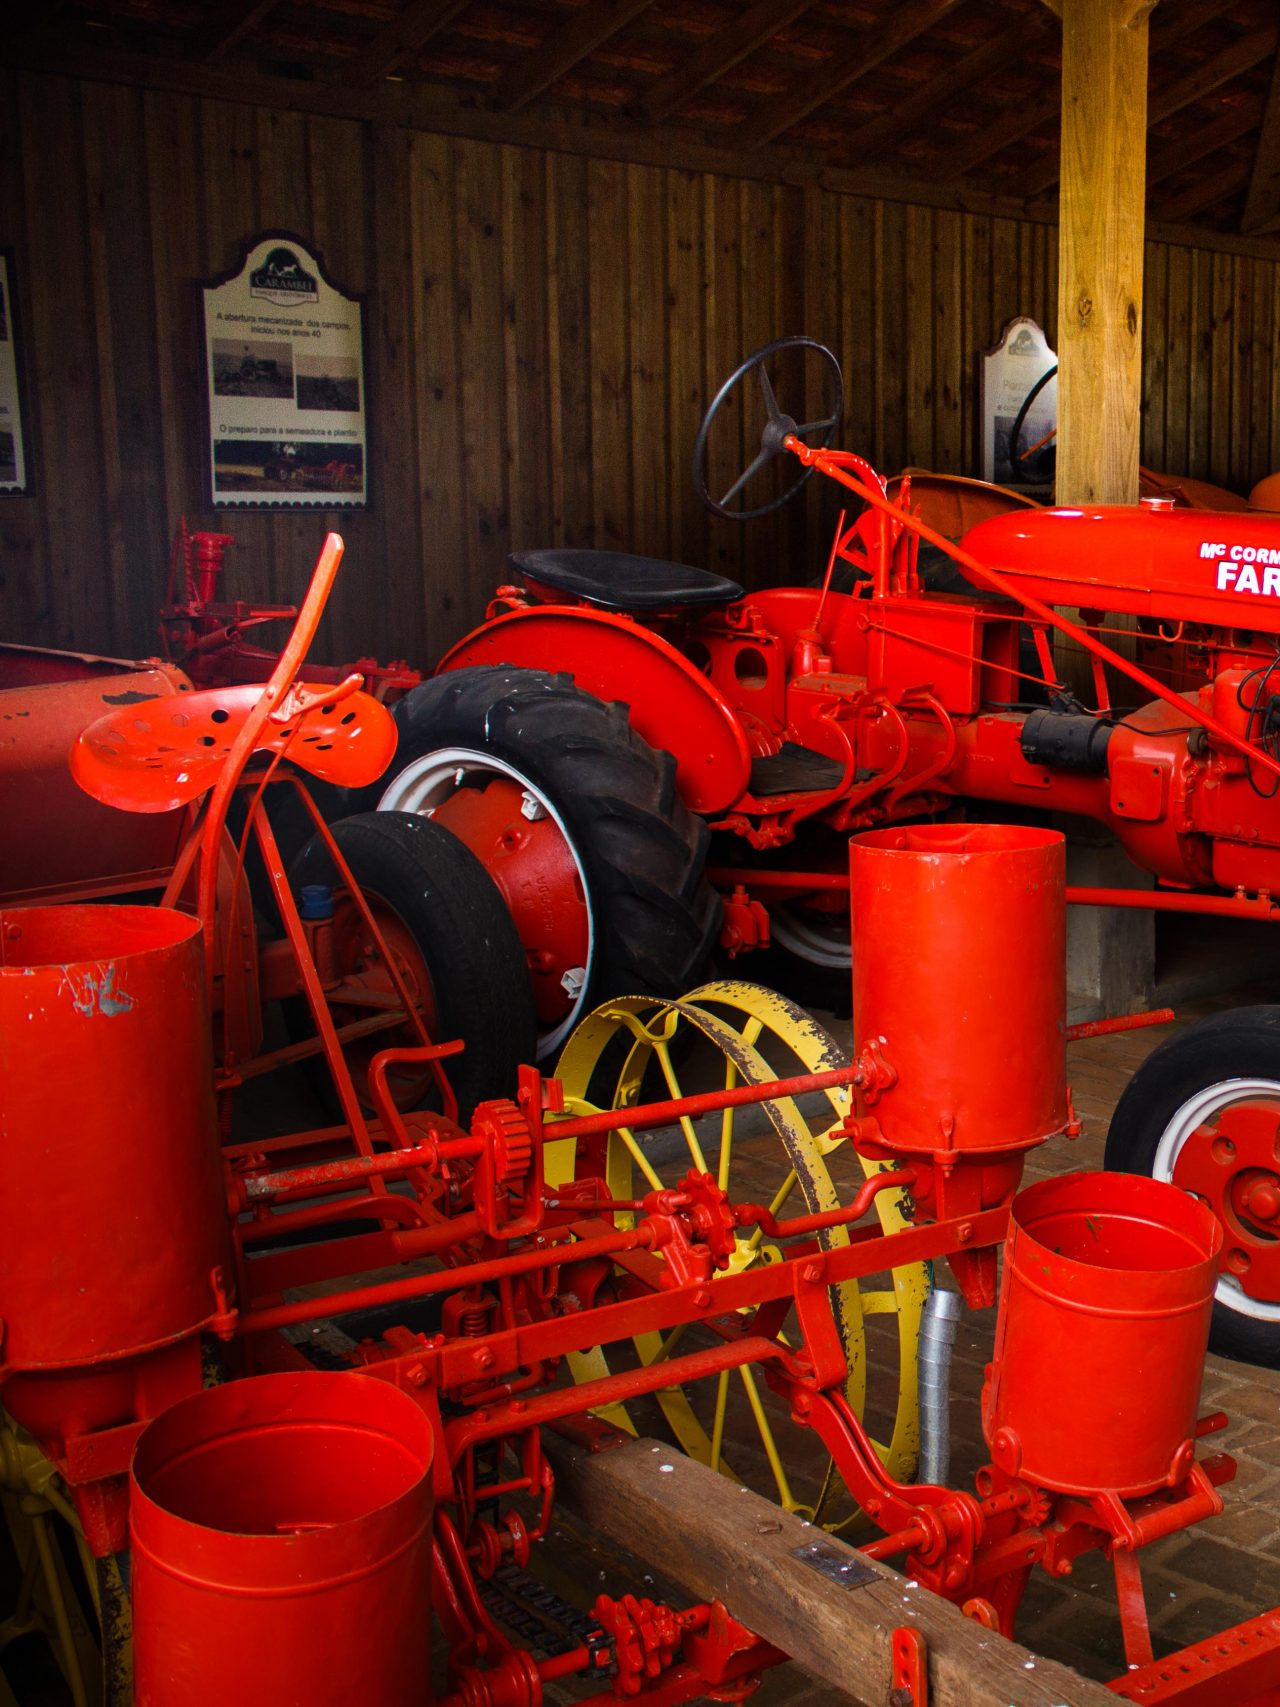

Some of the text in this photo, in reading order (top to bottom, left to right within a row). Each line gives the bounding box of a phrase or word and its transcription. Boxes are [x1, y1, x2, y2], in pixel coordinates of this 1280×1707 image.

[216, 312, 223, 320] A
[224, 313, 256, 322] abertura
[307, 319, 320, 328] dos
[277, 328, 291, 336] nos
[292, 329, 310, 337] anos
[312, 329, 321, 338] 40
[219, 424, 227, 433] O
[228, 426, 258, 436] preparo
[259, 427, 277, 436] para
